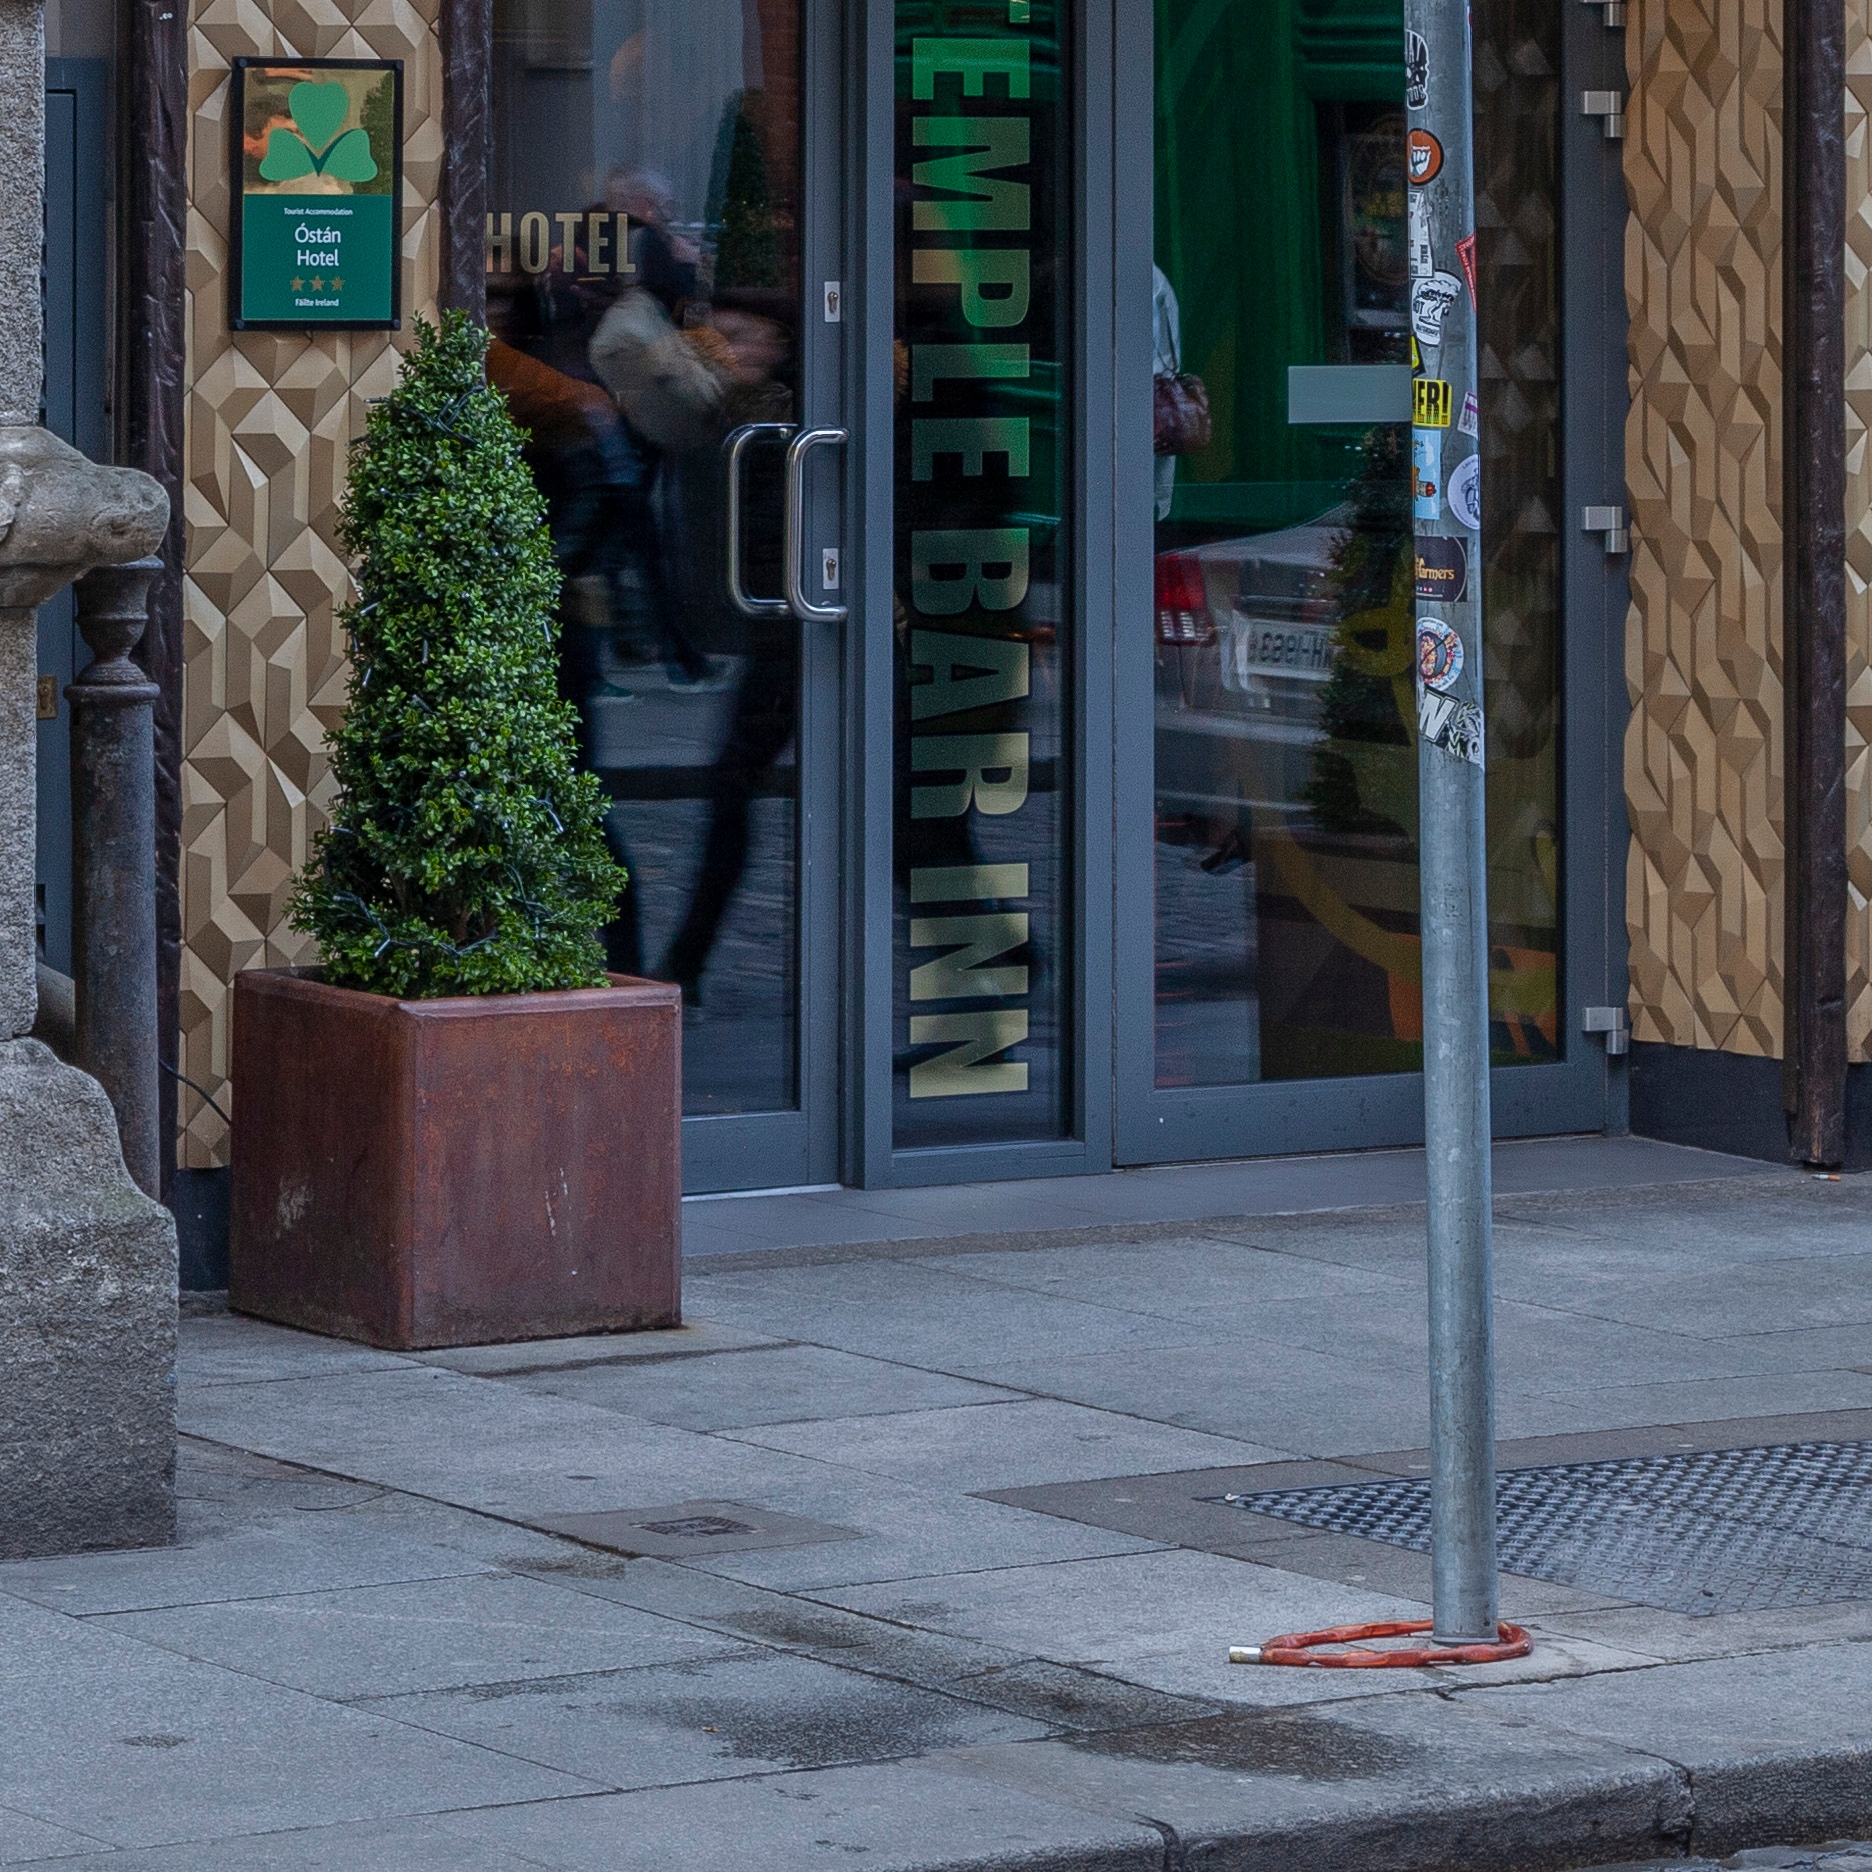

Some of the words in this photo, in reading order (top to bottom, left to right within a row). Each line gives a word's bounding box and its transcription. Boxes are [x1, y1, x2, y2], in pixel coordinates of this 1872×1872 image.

[294, 222, 342, 244] Óstán
[296, 248, 340, 267] Hotel
[486, 211, 637, 274] HOTEL
[910, 528, 1029, 819] BAR
[910, 862, 1029, 1098] INN
